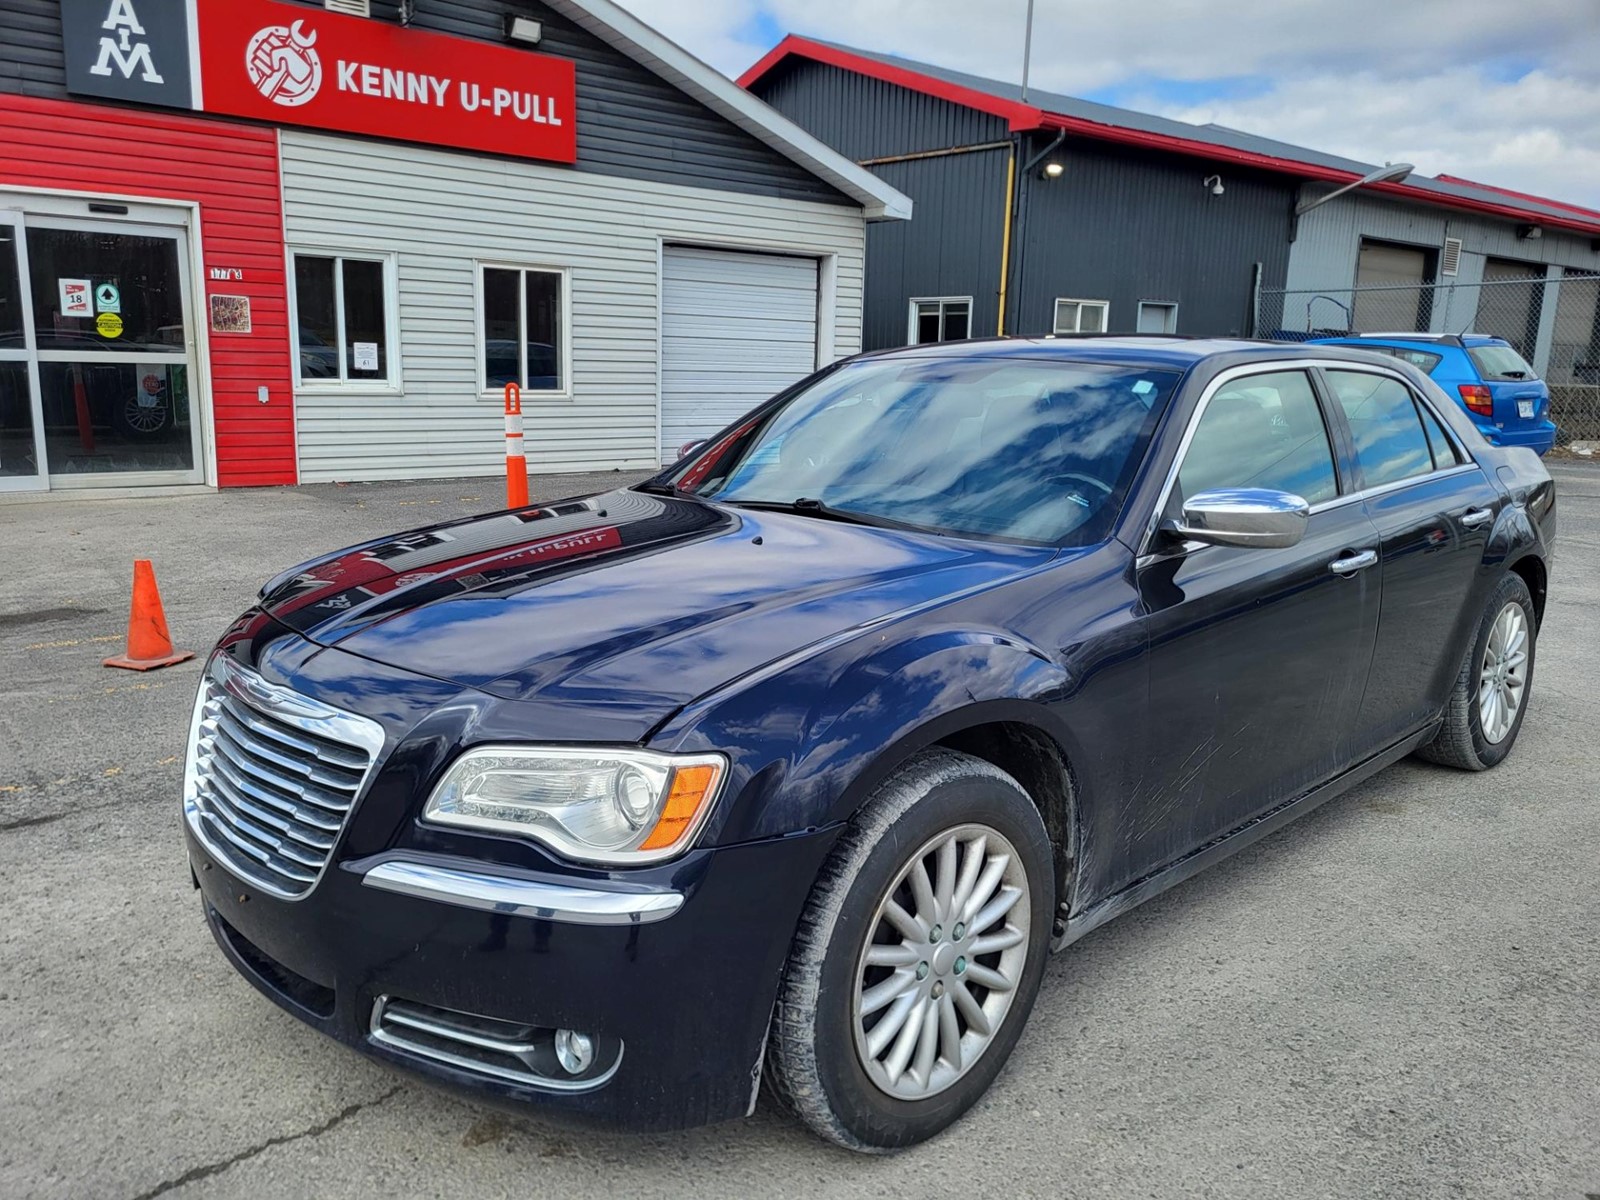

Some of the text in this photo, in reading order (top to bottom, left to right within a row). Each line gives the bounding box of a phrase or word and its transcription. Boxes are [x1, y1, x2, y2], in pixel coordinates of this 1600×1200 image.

[337, 59, 562, 126] KENNY U-PULL
[70, 294, 82, 303] 18
